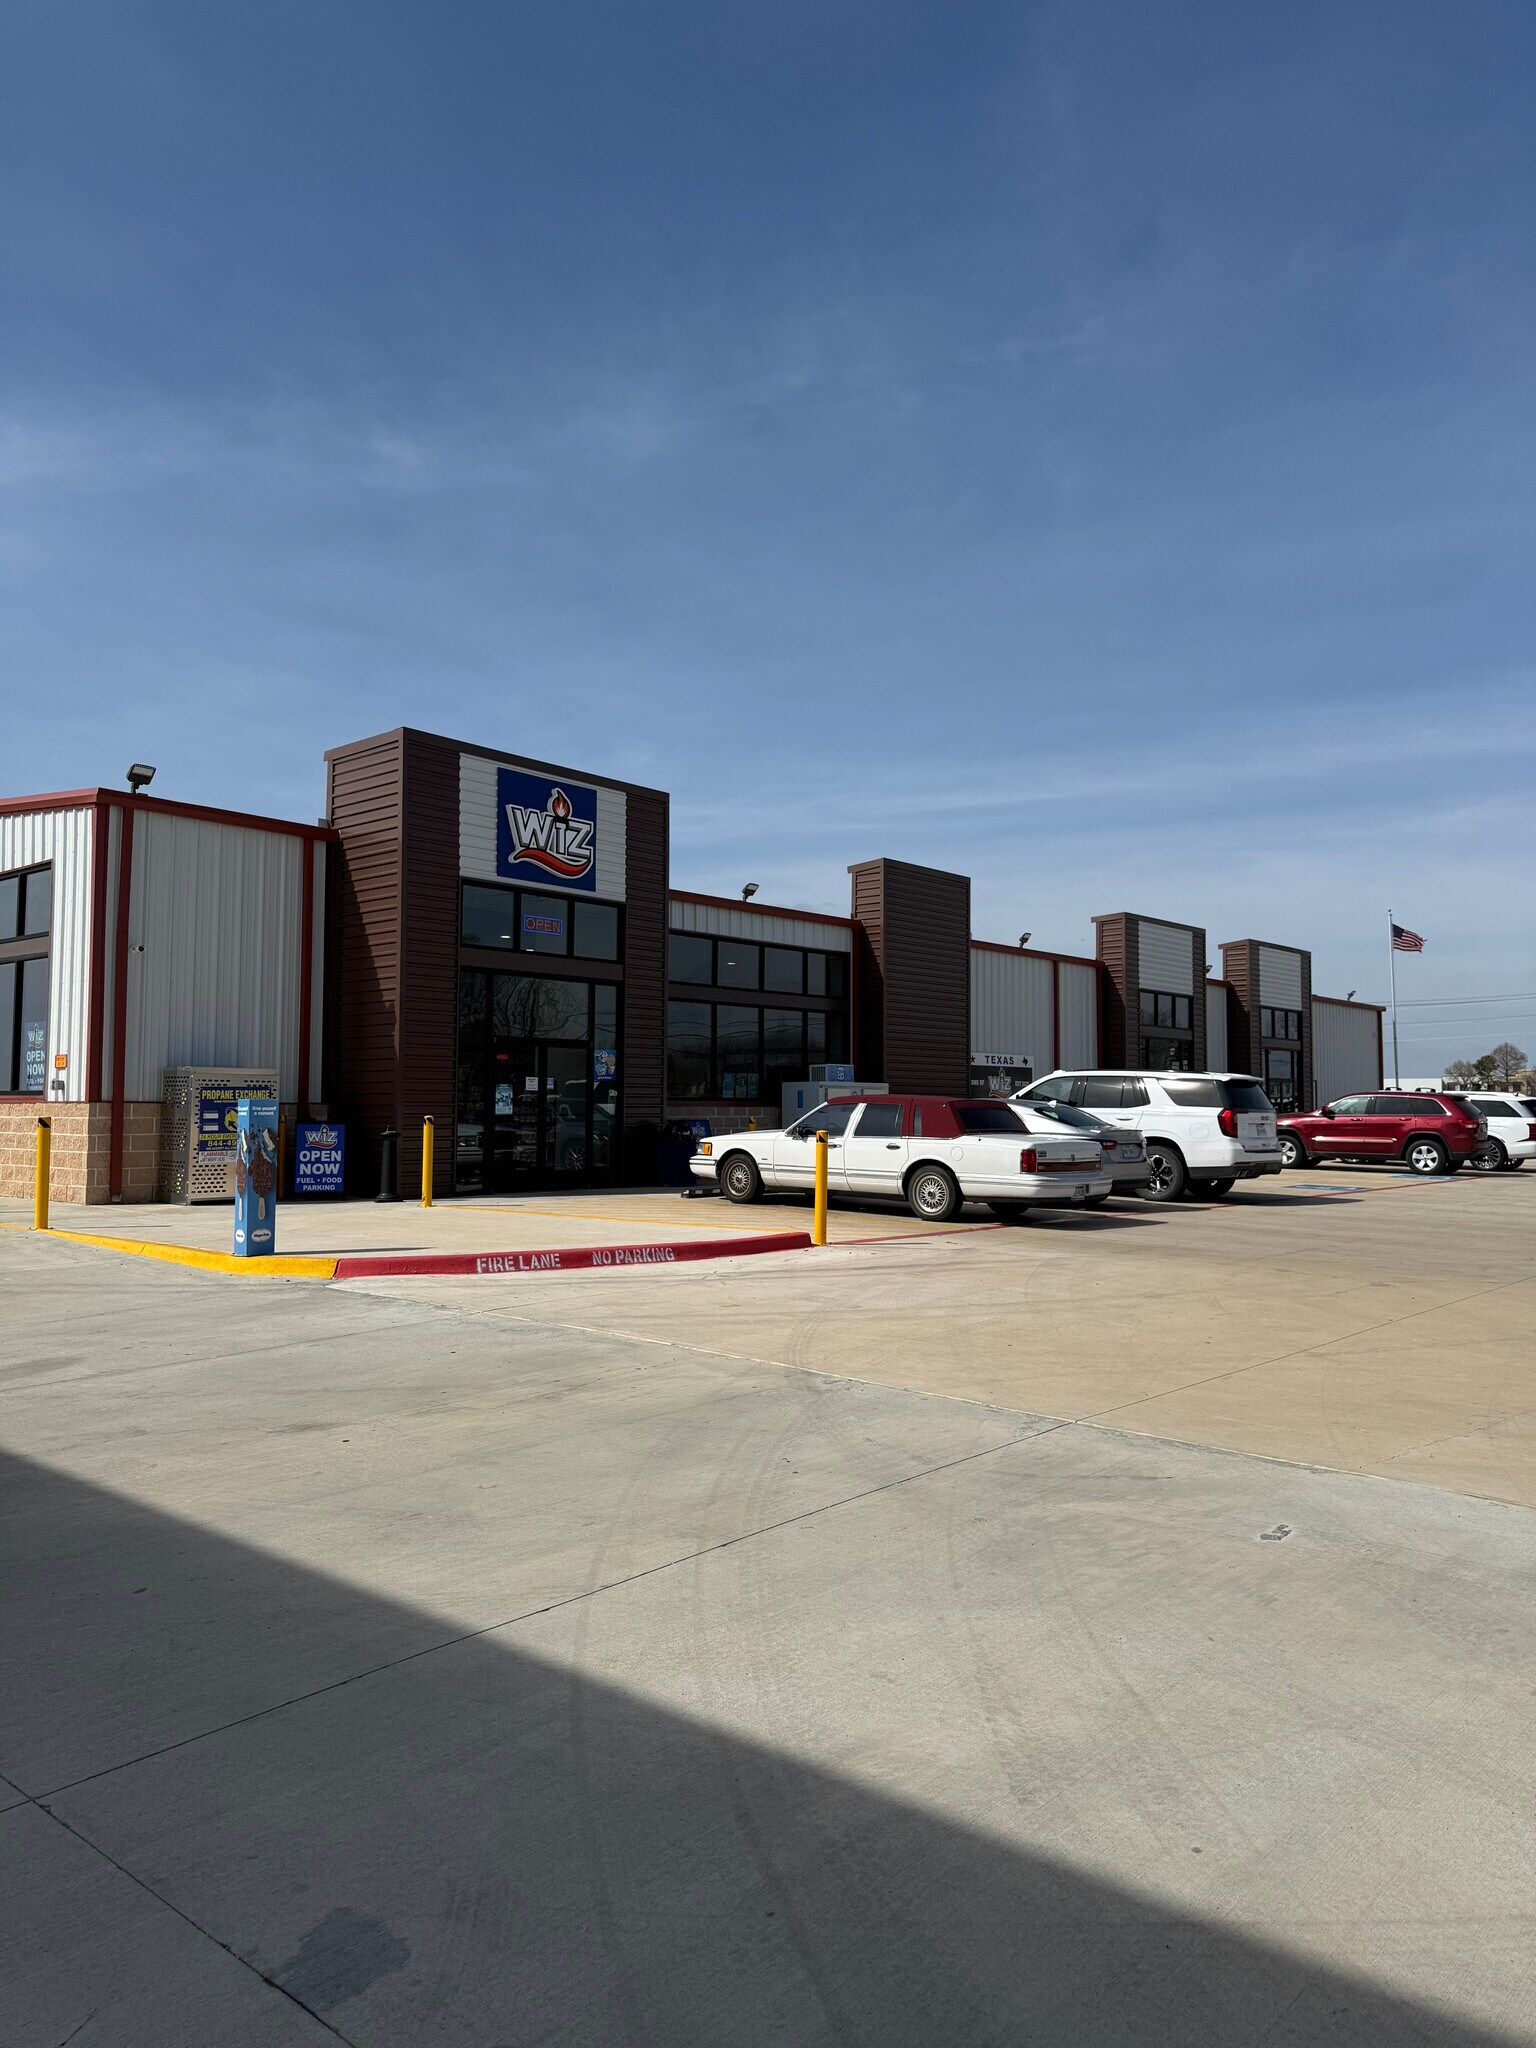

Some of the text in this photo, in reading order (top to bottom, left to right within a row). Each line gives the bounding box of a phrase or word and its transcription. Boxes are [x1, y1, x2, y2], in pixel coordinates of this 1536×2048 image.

[525, 917, 561, 933] OPEN
[985, 1055, 1014, 1065] TEXAS
[201, 1090, 270, 1100] PROPANE EXCHANGE
[299, 1150, 342, 1162] OPEN
[299, 1163, 340, 1175] NOW
[475, 1247, 675, 1274] FIRE LANE NO PARKING
